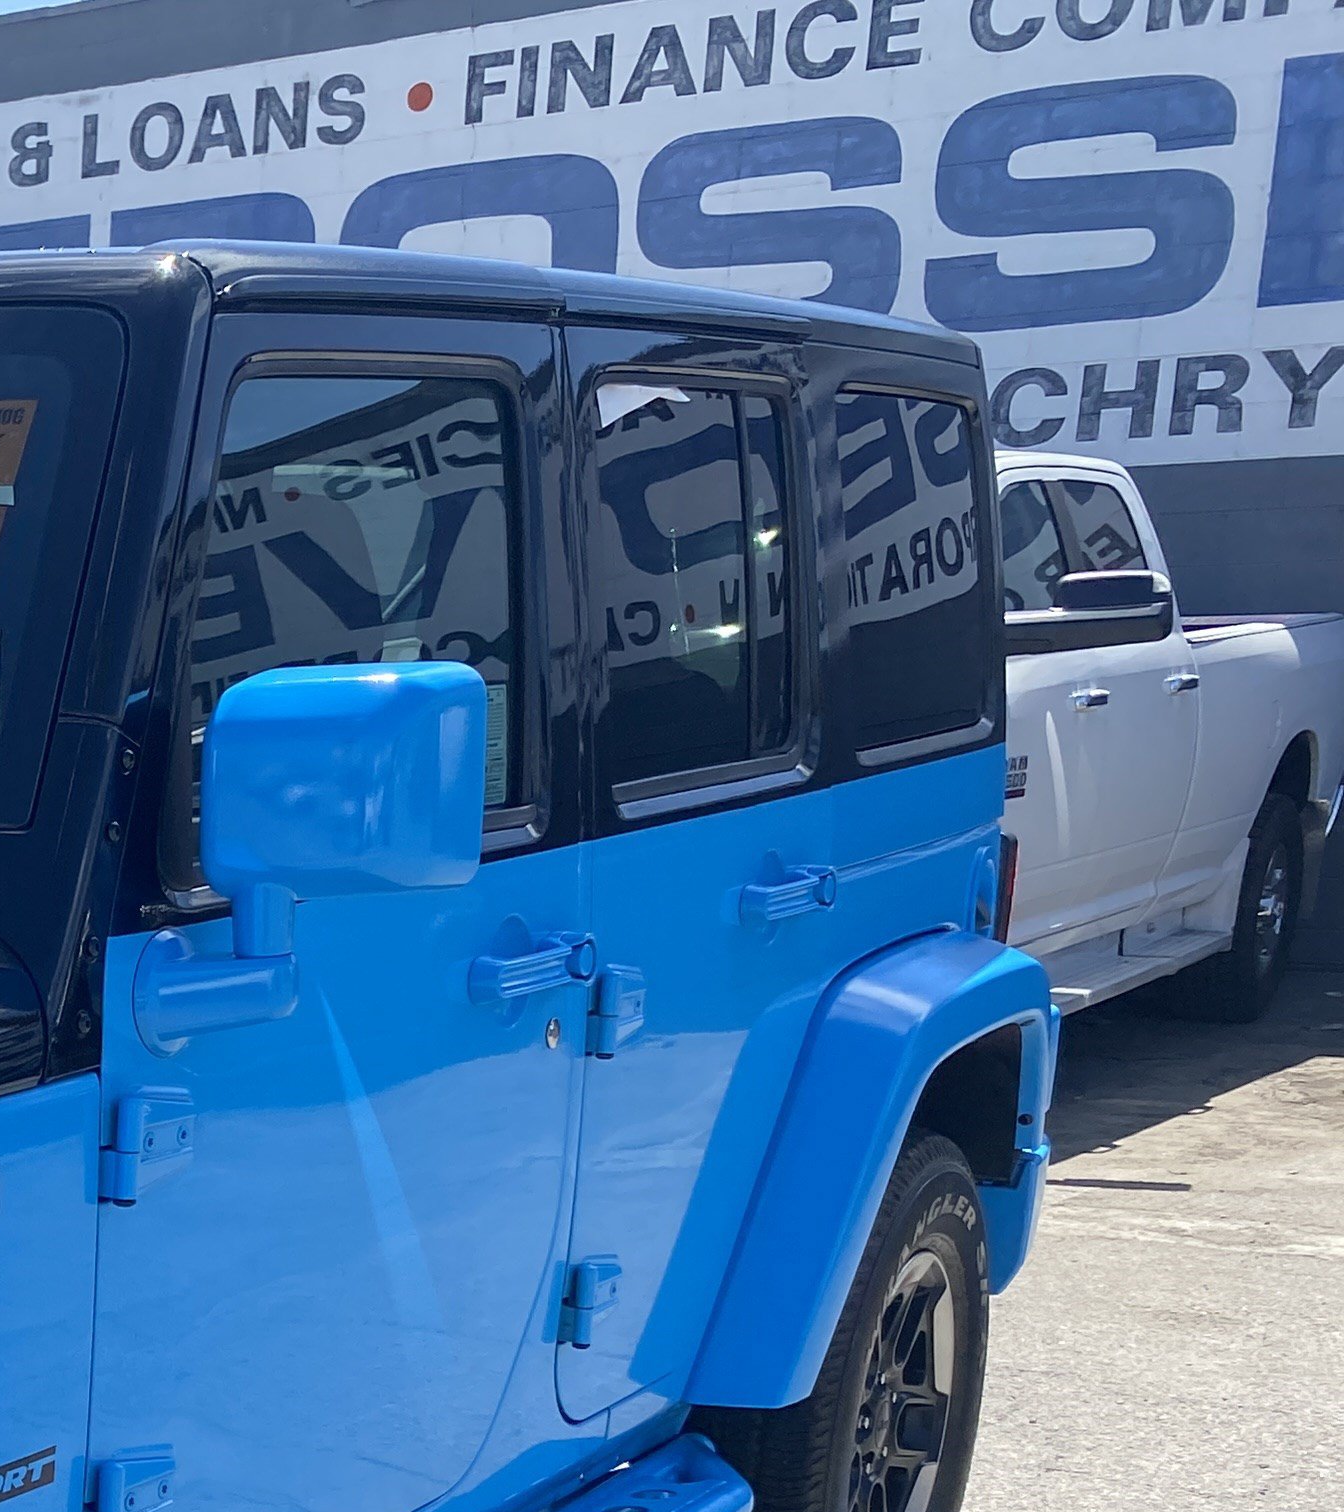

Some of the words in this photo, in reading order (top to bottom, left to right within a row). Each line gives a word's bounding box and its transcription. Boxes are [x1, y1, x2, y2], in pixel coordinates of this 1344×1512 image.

[9, 121, 54, 187] &
[81, 74, 367, 180] LOANS
[464, 0, 922, 126] FINANCE
[990, 346, 1344, 447] CHRY
